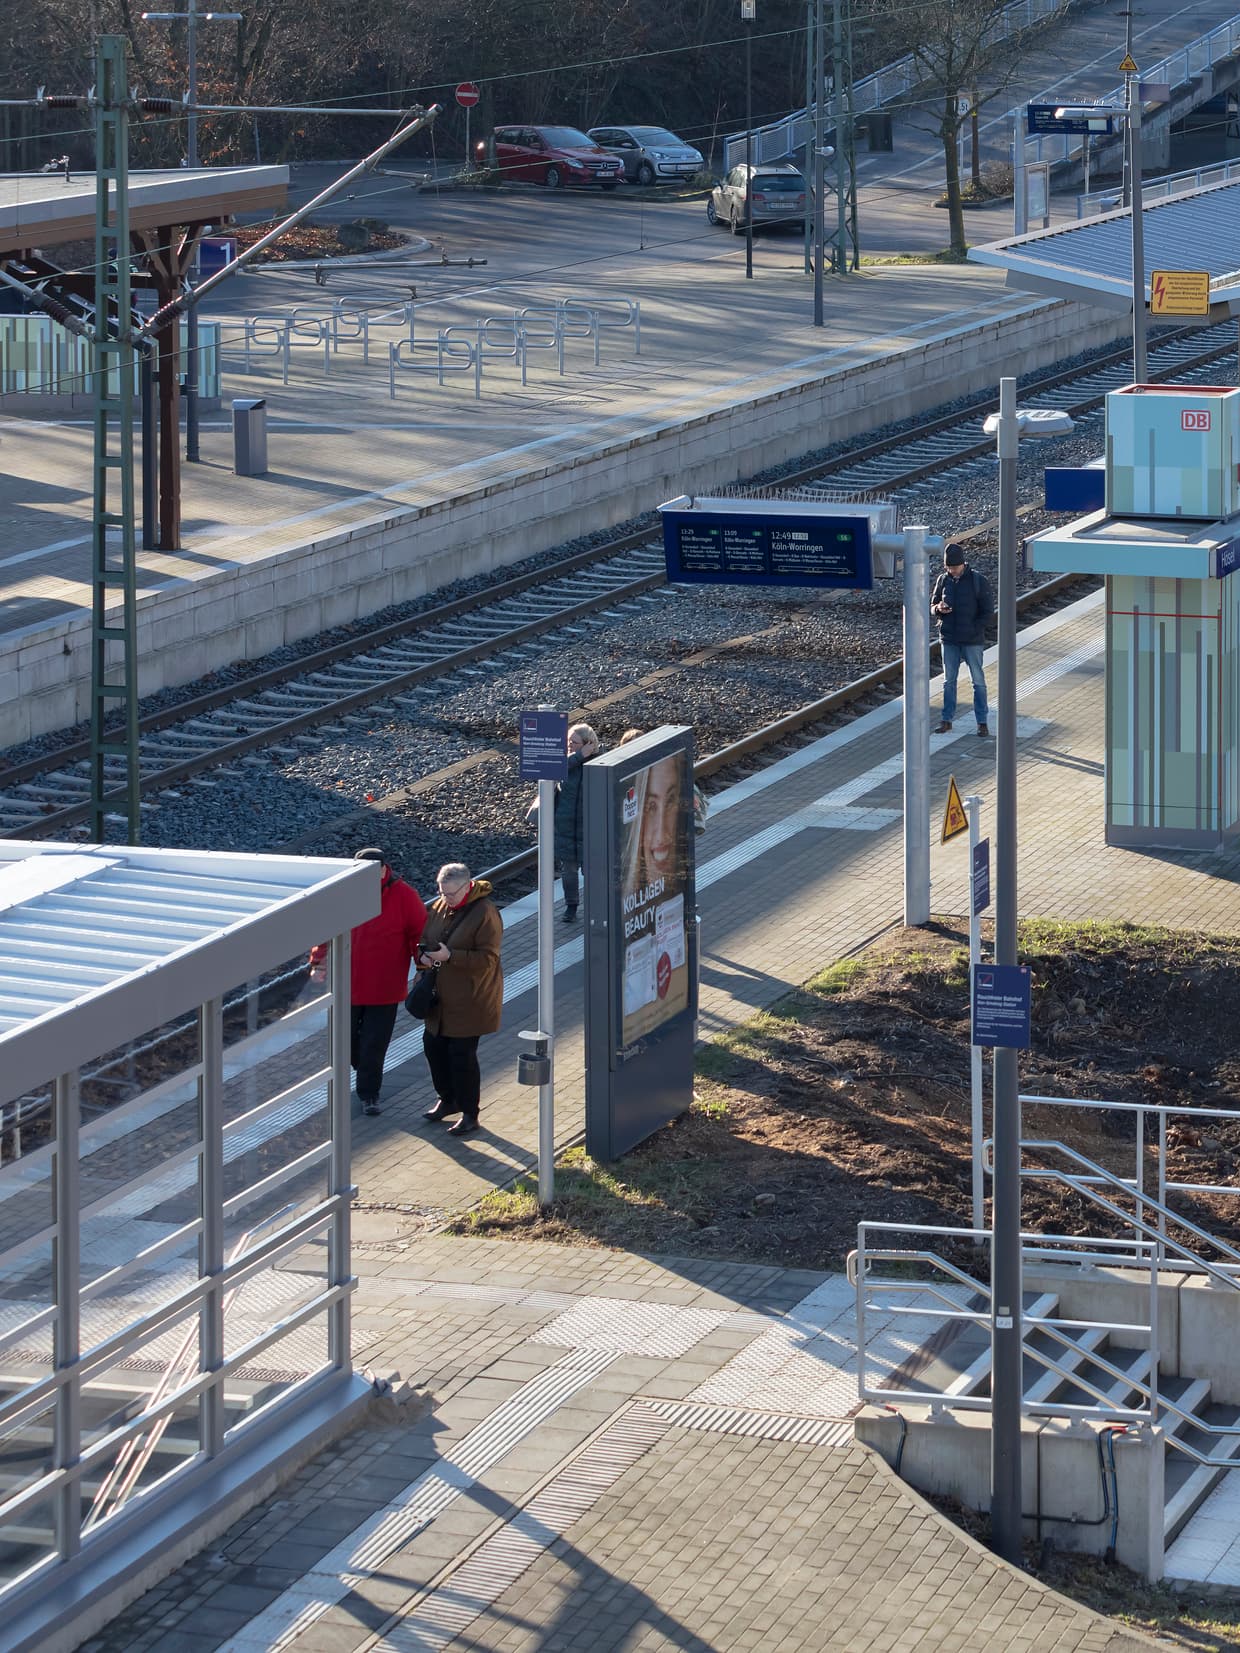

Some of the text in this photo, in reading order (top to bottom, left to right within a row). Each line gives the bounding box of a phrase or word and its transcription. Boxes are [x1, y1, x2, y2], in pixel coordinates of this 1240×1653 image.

[220, 242, 231, 265] 1
[1184, 412, 1208, 429] DB
[771, 531, 792, 541] 12:49
[771, 542, 823, 553] Köln-Worringen
[1221, 545, 1235, 567] Hösel
[623, 877, 665, 915] KOLLAGEN
[624, 905, 656, 938] BEAUTY
